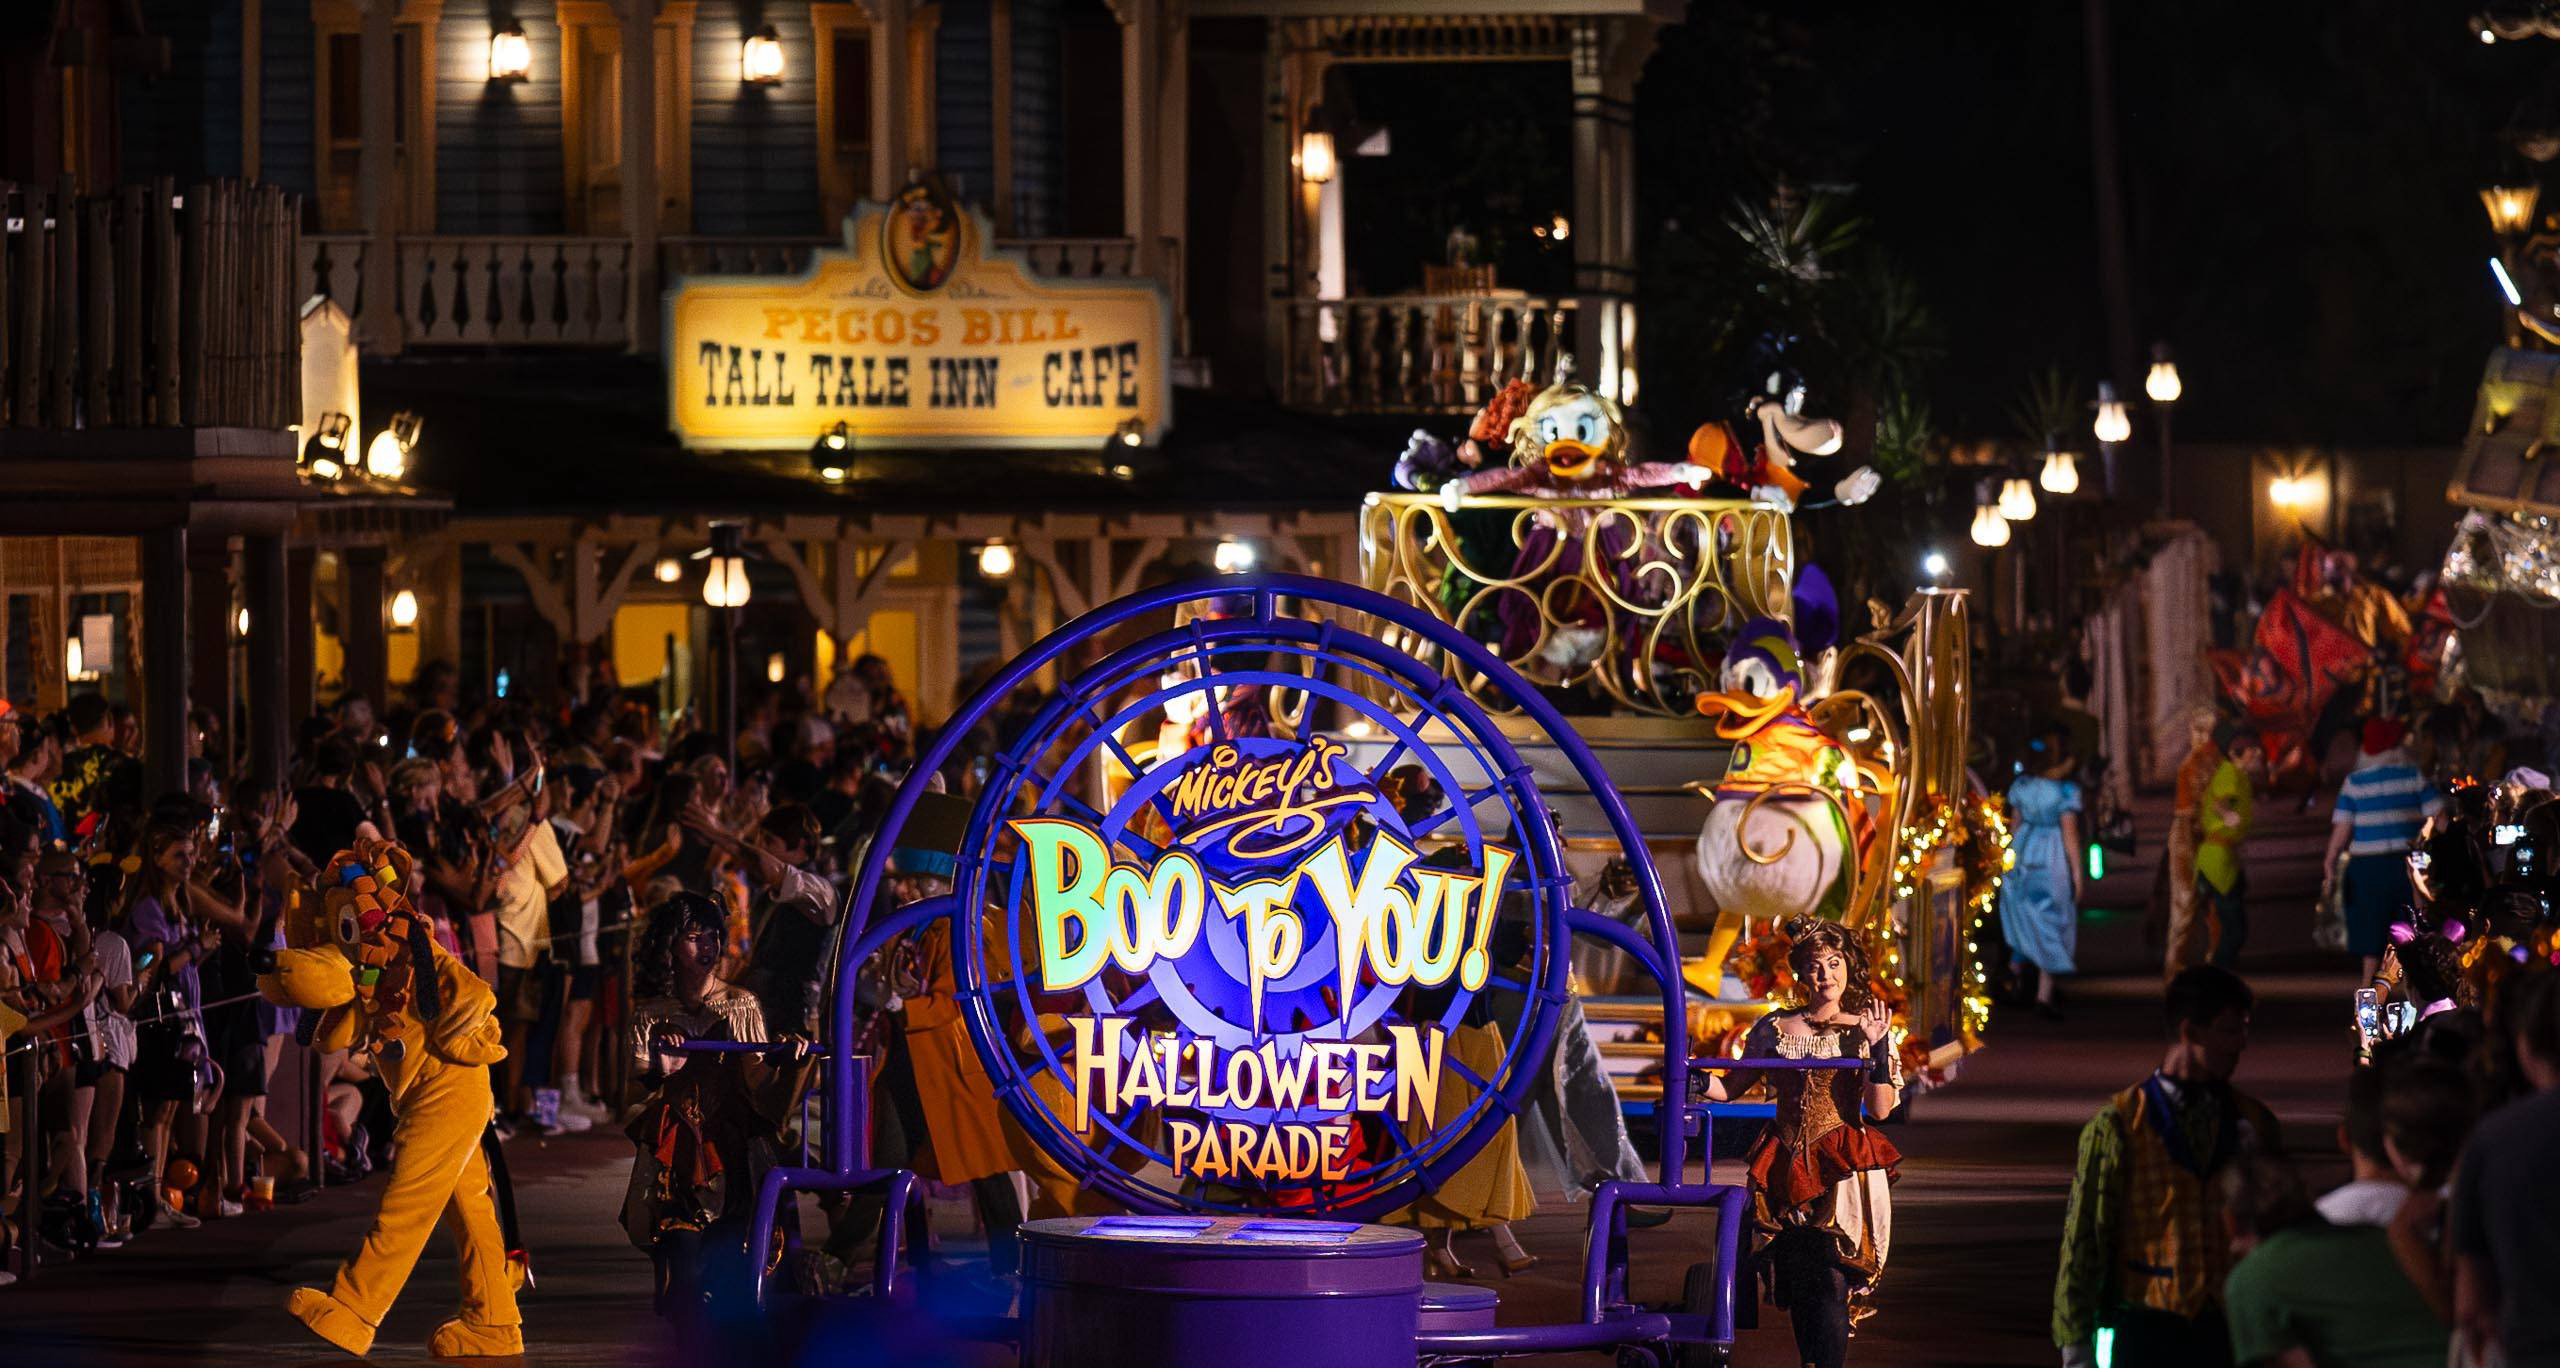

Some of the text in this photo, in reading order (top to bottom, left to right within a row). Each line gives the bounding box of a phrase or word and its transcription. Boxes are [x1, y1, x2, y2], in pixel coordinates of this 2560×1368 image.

[763, 308, 1080, 345] PECOS BILL
[699, 341, 1139, 408] TALL TALE INN CAFE
[1008, 819, 1516, 1037] BOO TO YOU!
[1068, 1016, 1445, 1133] HALLOWEEN
[1171, 1120, 1350, 1180] PARADE
